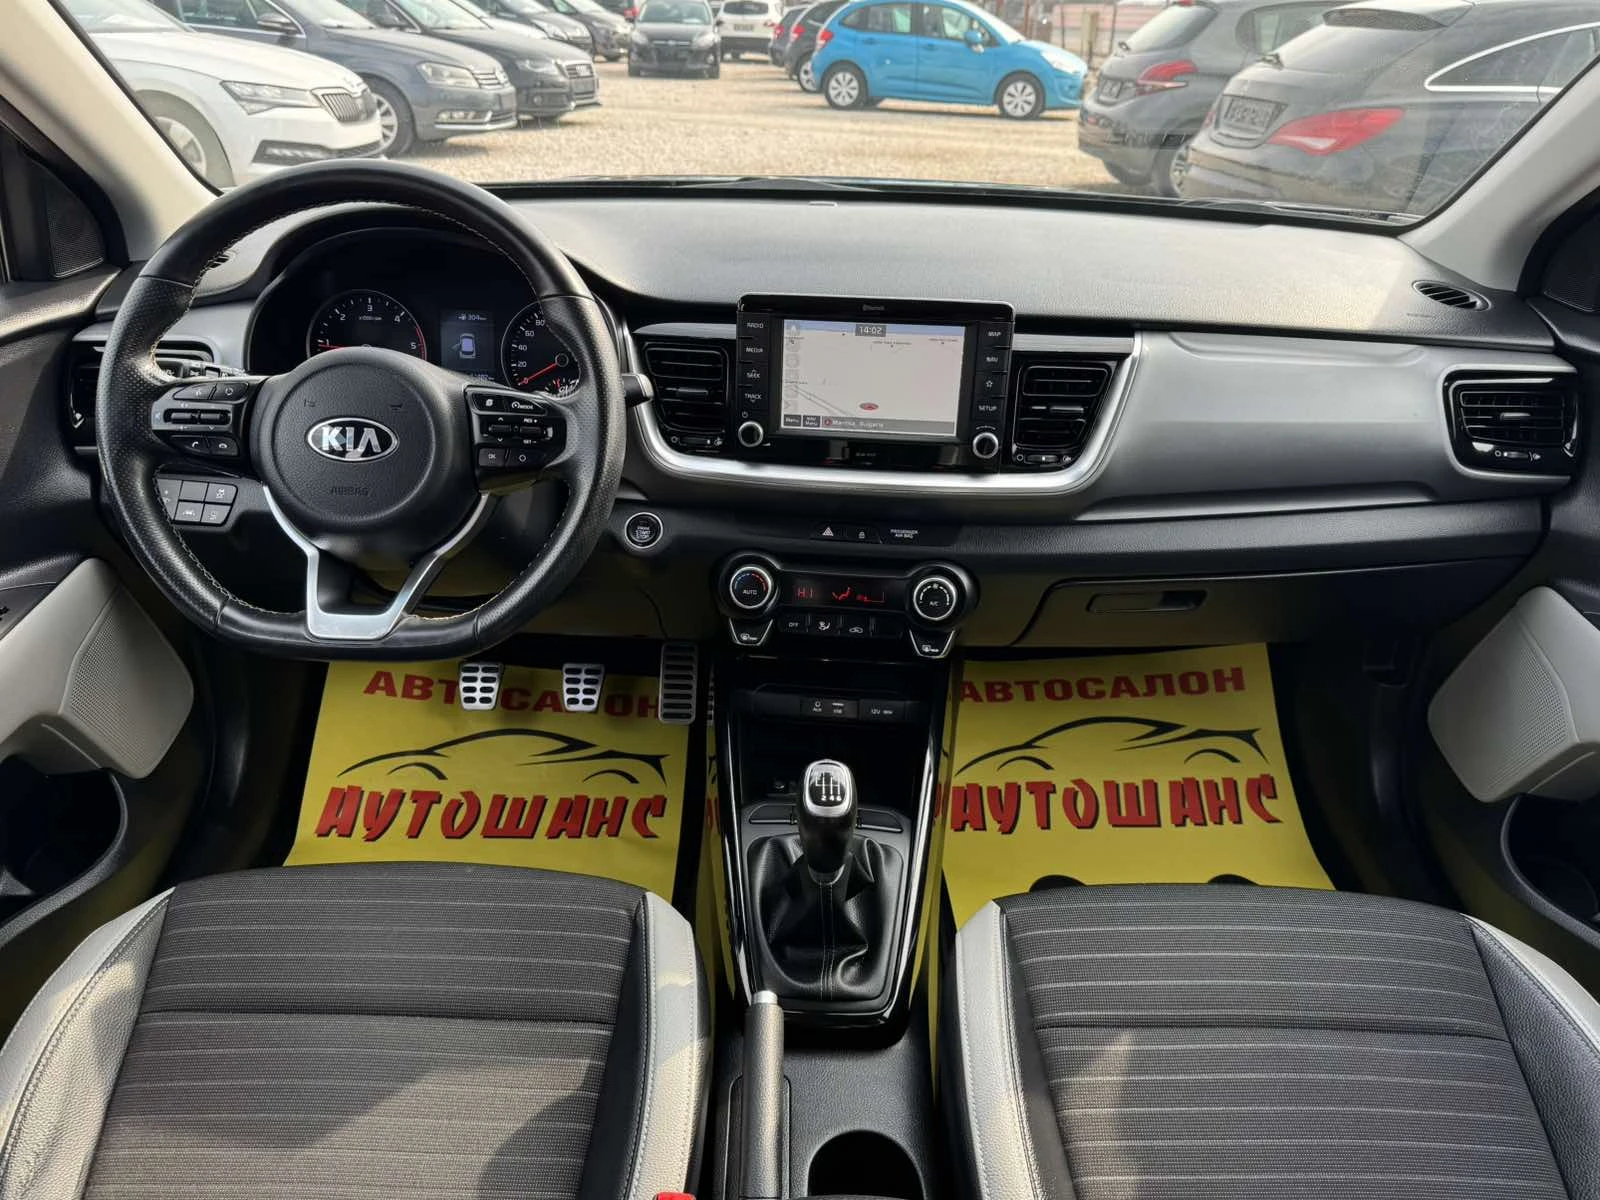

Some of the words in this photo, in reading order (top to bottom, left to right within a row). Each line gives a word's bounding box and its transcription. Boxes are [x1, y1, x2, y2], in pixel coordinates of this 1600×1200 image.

[367, 304, 373, 312] 3
[394, 315, 401, 323] 4
[535, 319, 545, 327] 80
[859, 325, 882, 335] 14:02
[410, 341, 417, 350] 5
[518, 344, 528, 352] 40
[321, 426, 382, 453] KIA
[959, 667, 1246, 704] АВТОСАЛОН
[363, 670, 660, 718] АВТСАОН
[950, 773, 1284, 835] АУТОШАНС
[315, 784, 668, 842] АУТОШАНС
